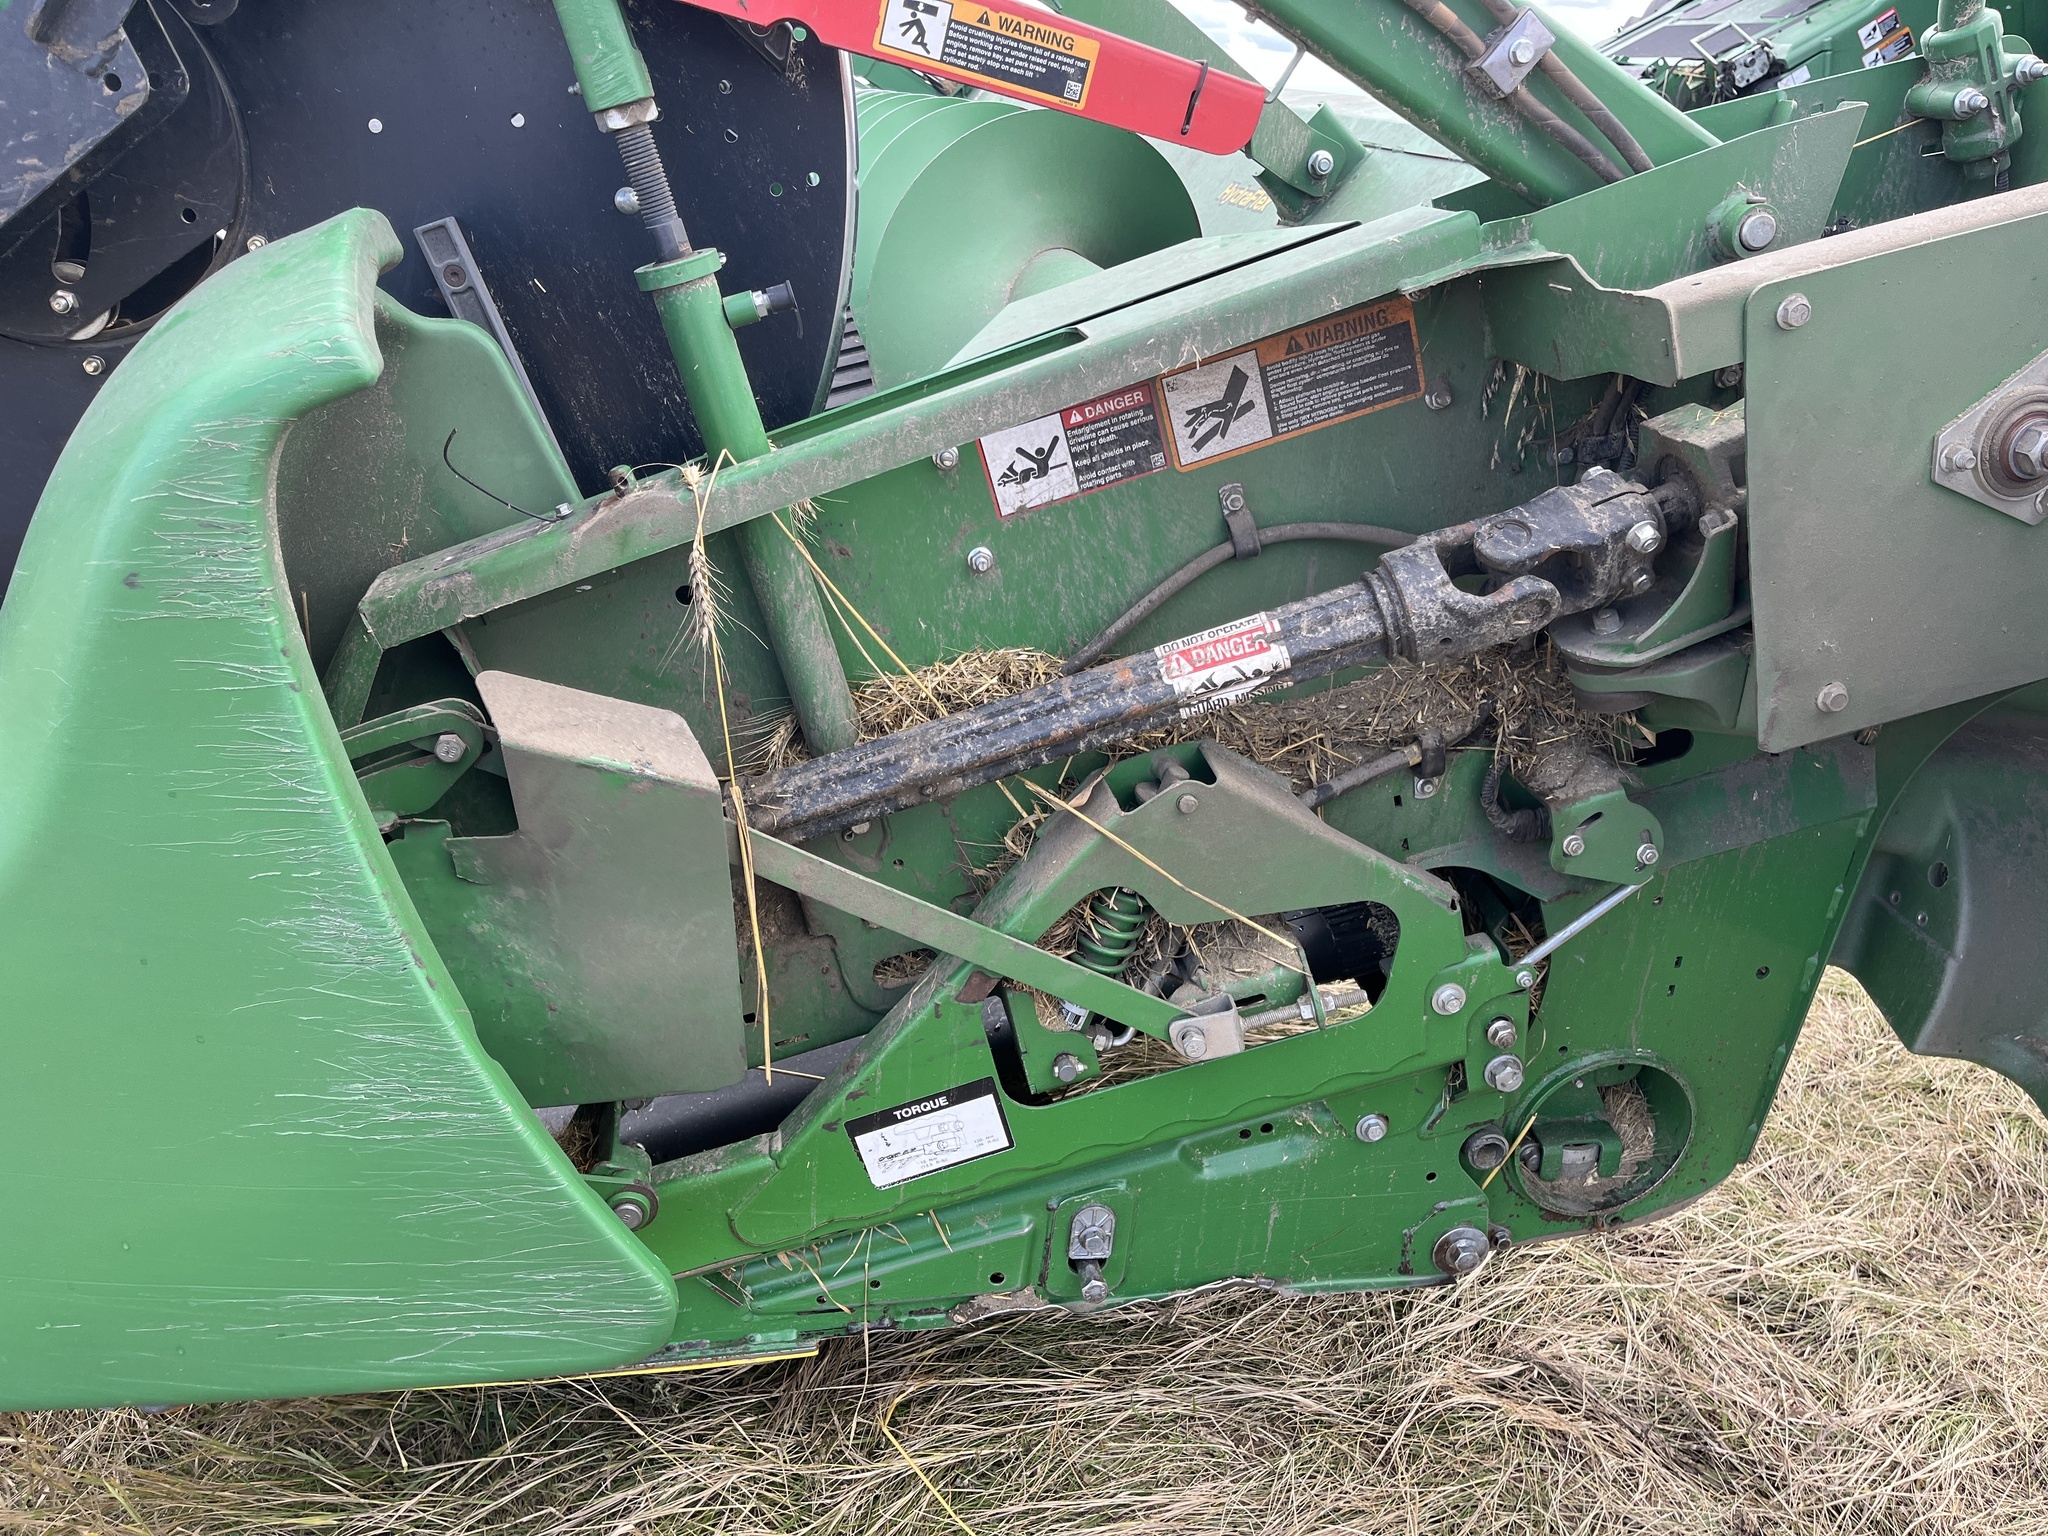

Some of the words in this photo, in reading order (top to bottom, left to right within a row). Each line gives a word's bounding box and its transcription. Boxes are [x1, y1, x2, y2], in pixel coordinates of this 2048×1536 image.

[949, 21, 968, 32] Avoid
[967, 27, 995, 41] crushing
[995, 35, 1018, 48] injuries
[1018, 42, 1032, 52] from
[1033, 47, 1043, 55] fall
[1055, 53, 1074, 64] raised
[1074, 59, 1087, 69] reel.
[998, 15, 1074, 51] WARNING
[941, 54, 966, 68] cylinder
[967, 62, 980, 71] rod.
[944, 47, 956, 55] and
[967, 53, 985, 65] safety
[985, 59, 1000, 69] stop
[1009, 66, 1024, 75] each
[945, 38, 968, 51] engine,
[968, 46, 991, 57] remove
[991, 52, 1004, 62] key,
[1014, 59, 1029, 69] park
[1029, 63, 1046, 73] brake
[947, 30, 968, 41] Before
[968, 36, 993, 50] working
[1010, 49, 1028, 59] under
[1028, 54, 1047, 65] raised
[1047, 60, 1060, 70] reel,
[1060, 65, 1074, 74] stop
[1216, 182, 1272, 213] HydraFlex
[1306, 309, 1388, 348] WARNING
[1313, 348, 1326, 356] from
[1085, 391, 1144, 418] DANGER
[1066, 418, 1110, 438] Entanglement
[1118, 408, 1143, 422] rotating
[1068, 431, 1096, 445] driveline
[1096, 428, 1109, 436] can
[1109, 422, 1129, 432] cause
[1129, 414, 1153, 426] serious
[1070, 442, 1089, 454] injury
[1098, 433, 1118, 444] death.
[1074, 456, 1091, 468] Keep
[1091, 454, 1100, 462] all
[1100, 446, 1123, 459] shields
[1131, 438, 1151, 451] place.
[1077, 470, 1096, 482] Avoid
[1096, 463, 1121, 476] contact
[1121, 459, 1135, 468] with
[1079, 477, 1105, 490] rotating
[1105, 471, 1123, 482] parts.
[1162, 641, 1180, 653] DO
[1182, 633, 1205, 648] NOT
[1191, 631, 1268, 668] DANGER
[1188, 696, 1230, 717] GUARD
[893, 1096, 949, 1120] TORQUE
